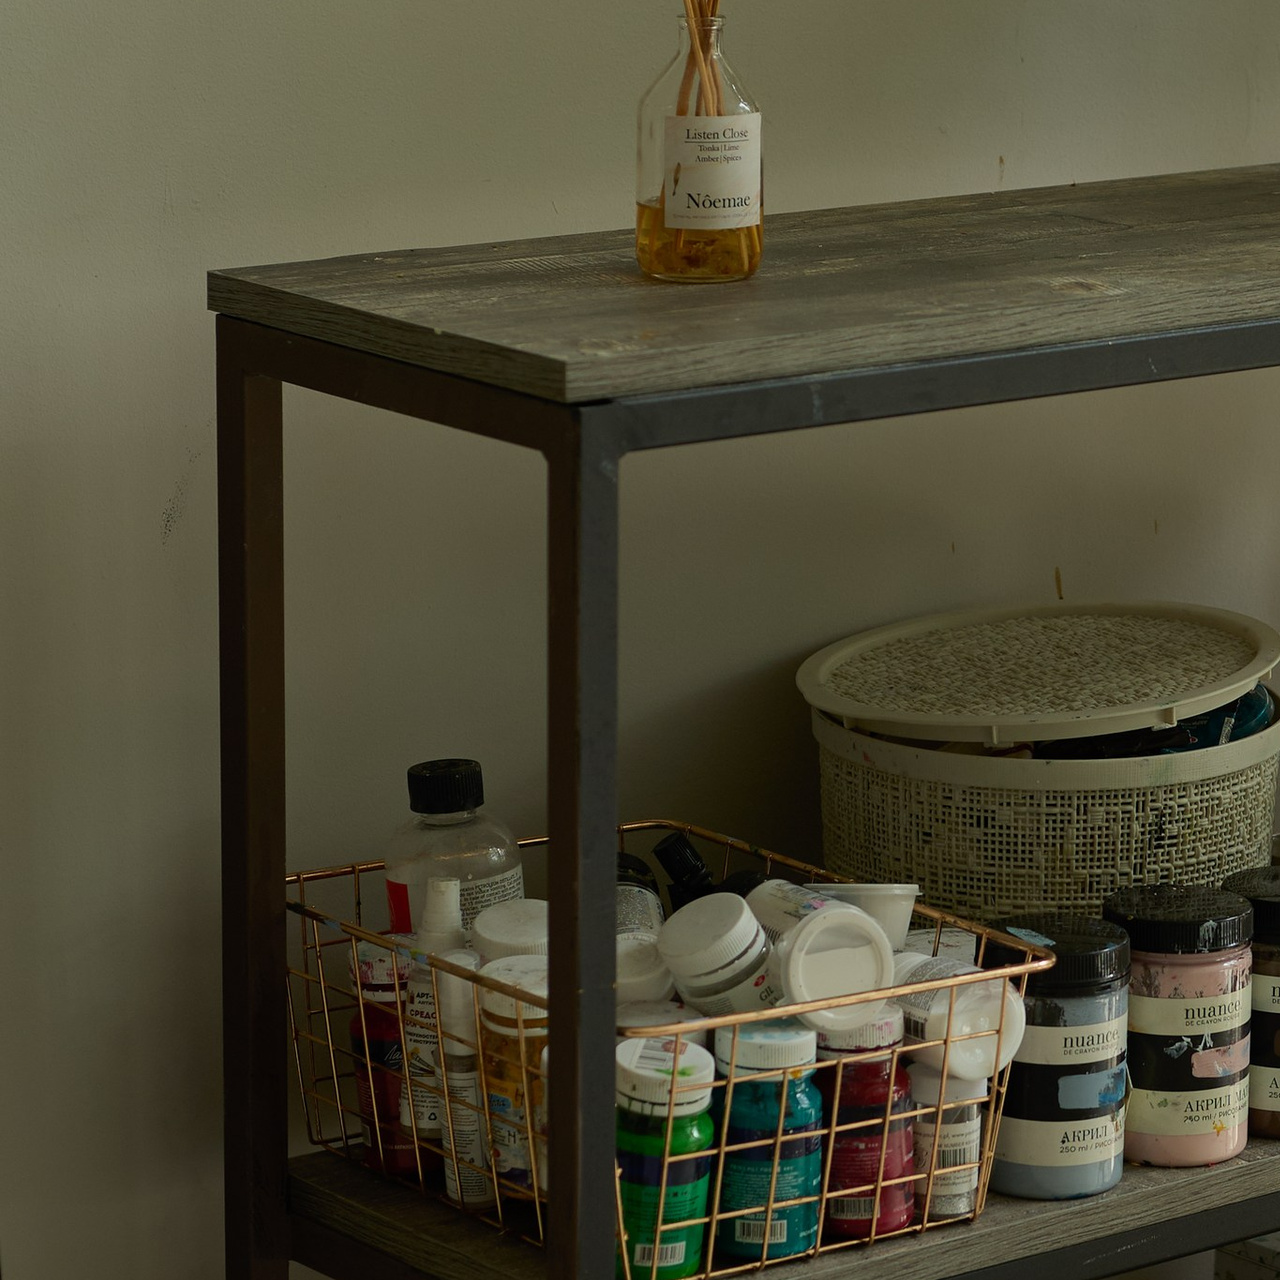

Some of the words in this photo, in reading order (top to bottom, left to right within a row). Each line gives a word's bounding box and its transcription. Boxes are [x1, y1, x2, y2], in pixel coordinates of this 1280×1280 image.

[686, 128, 719, 140] Listen
[723, 128, 748, 139] Close
[1185, 1000, 1242, 1019] nuance.
[1063, 1029, 1120, 1048] nuance.
[1184, 1094, 1231, 1112] АКРИЛ
[1061, 1126, 1107, 1143] АКРИЛ
[1078, 1144, 1088, 1152] ml
